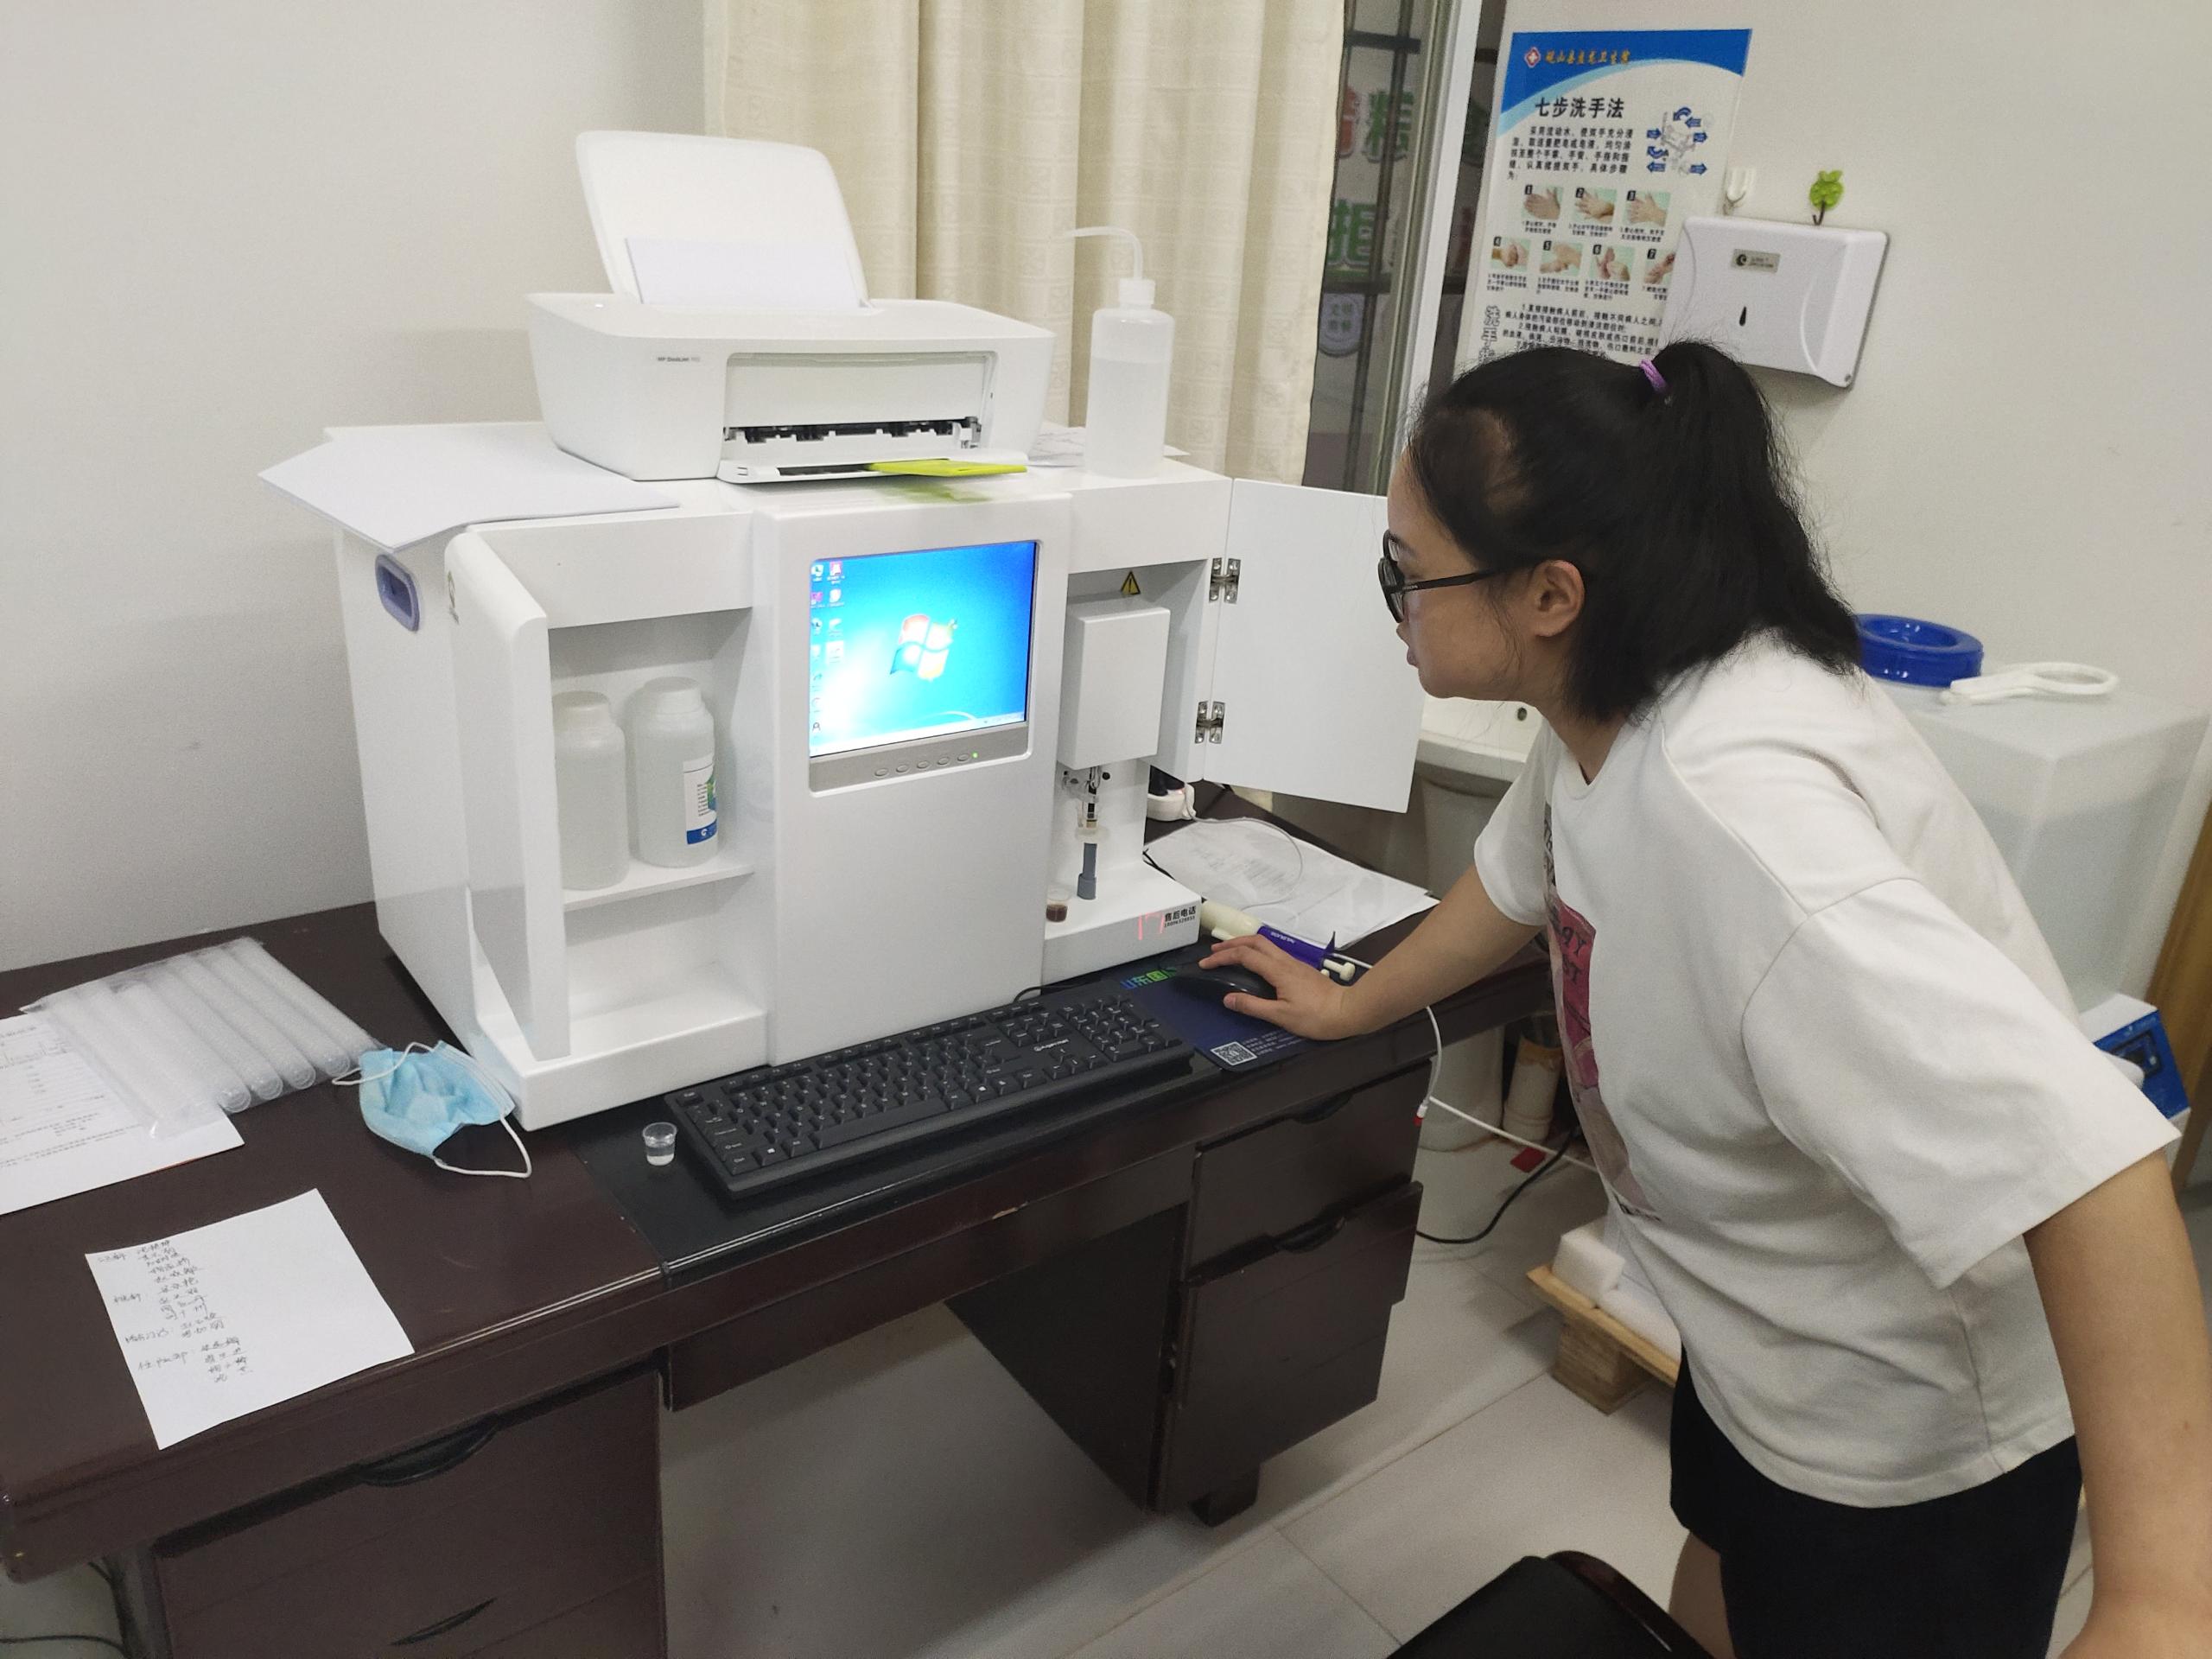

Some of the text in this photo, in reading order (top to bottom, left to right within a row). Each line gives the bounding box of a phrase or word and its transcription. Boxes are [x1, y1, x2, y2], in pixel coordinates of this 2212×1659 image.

[1535, 97, 1624, 118] 七步洗手法
[1165, 906, 1197, 922] 售后电话
